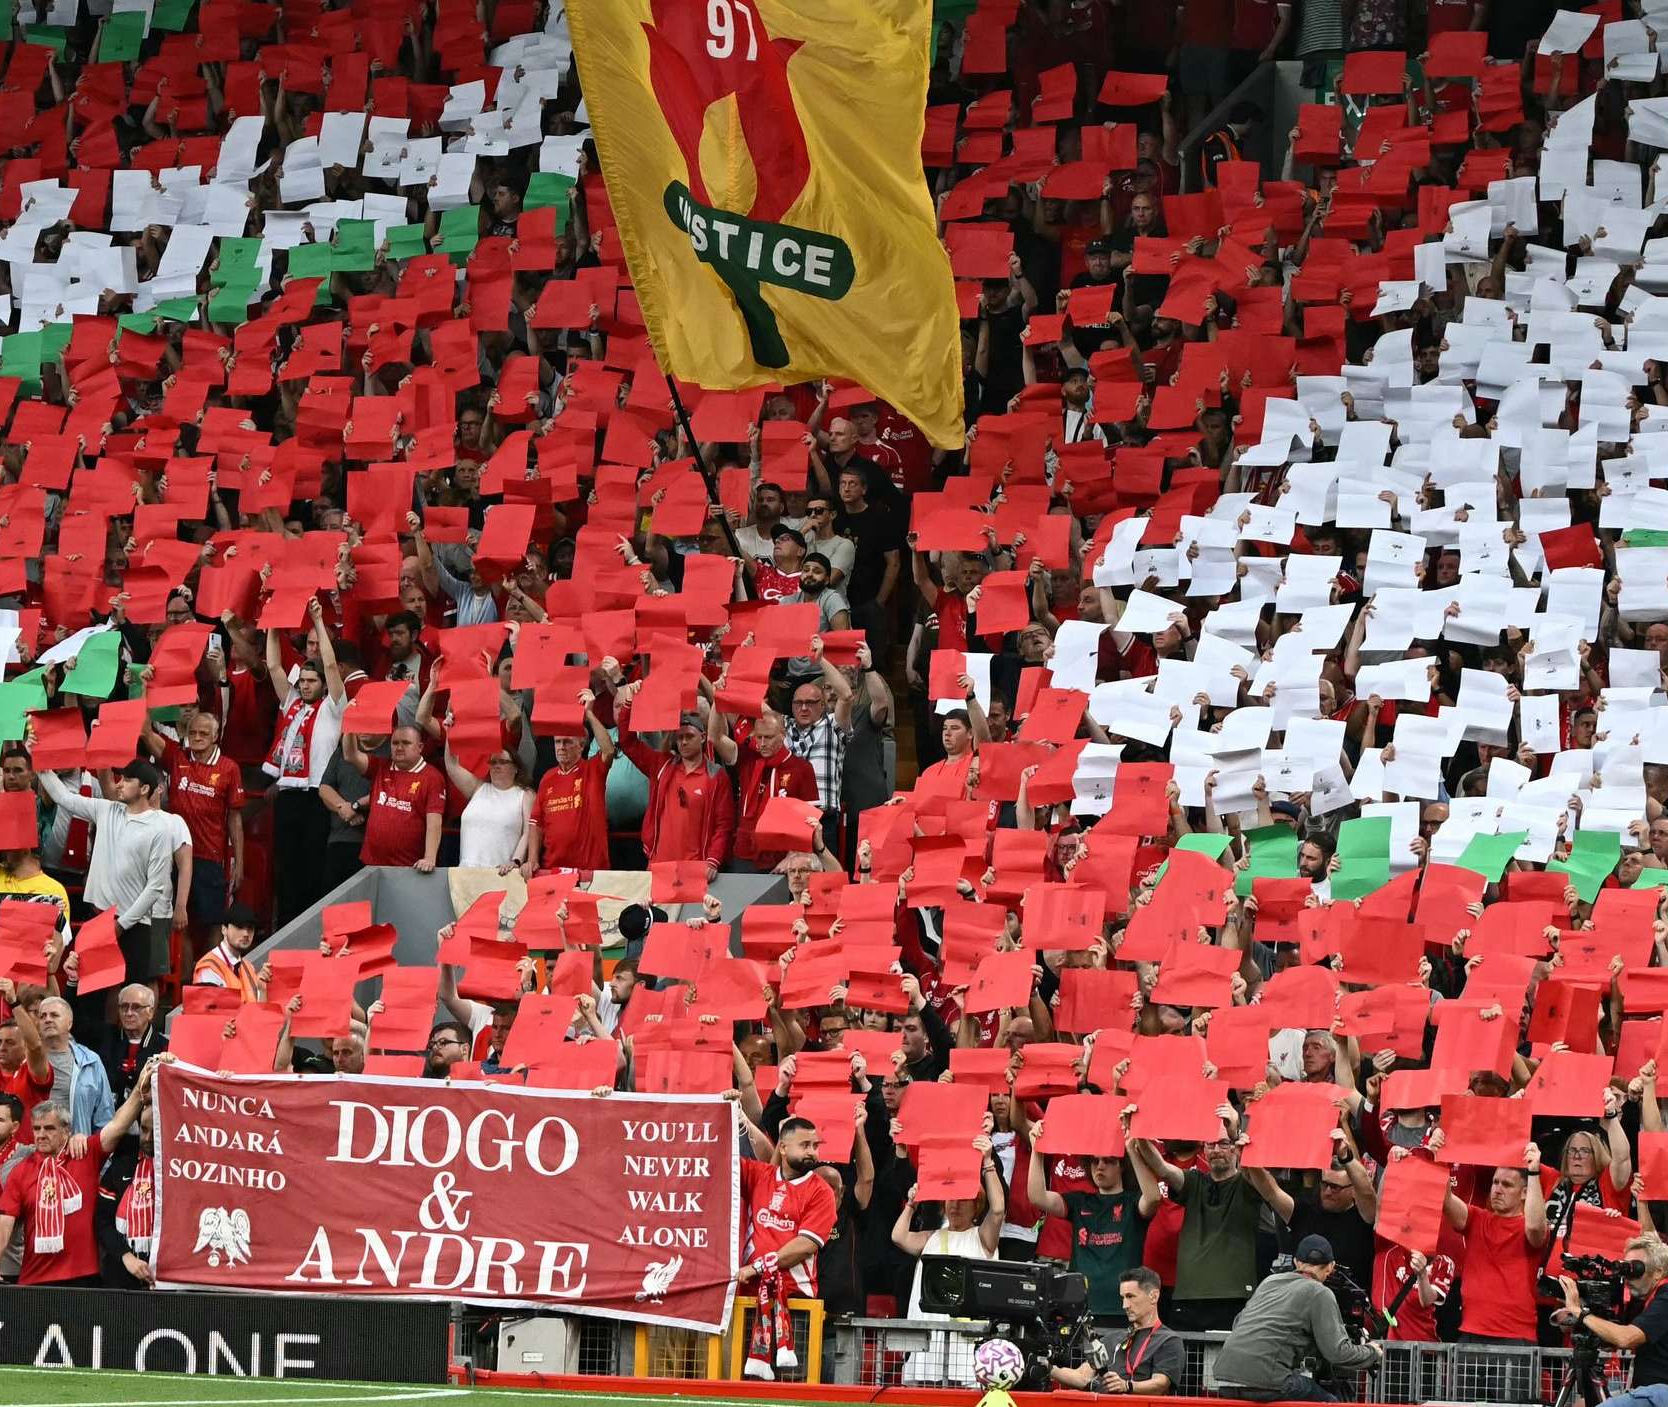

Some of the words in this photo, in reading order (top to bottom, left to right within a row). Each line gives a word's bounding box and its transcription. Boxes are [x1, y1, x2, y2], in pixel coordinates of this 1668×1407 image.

[182, 1088, 276, 1120] NUNCA
[174, 1126, 284, 1156] ANDARÁ
[326, 1100, 579, 1177] DIOGO
[621, 1120, 719, 1144] YOU'LL
[169, 1158, 286, 1192] SOZINHO
[624, 1155, 711, 1178] NEVER
[418, 1170, 473, 1233] &
[627, 1190, 703, 1214] WALK
[756, 1208, 795, 1231] Carlsberg
[618, 1225, 709, 1249] ALONE
[284, 1226, 590, 1298] ANDRE
